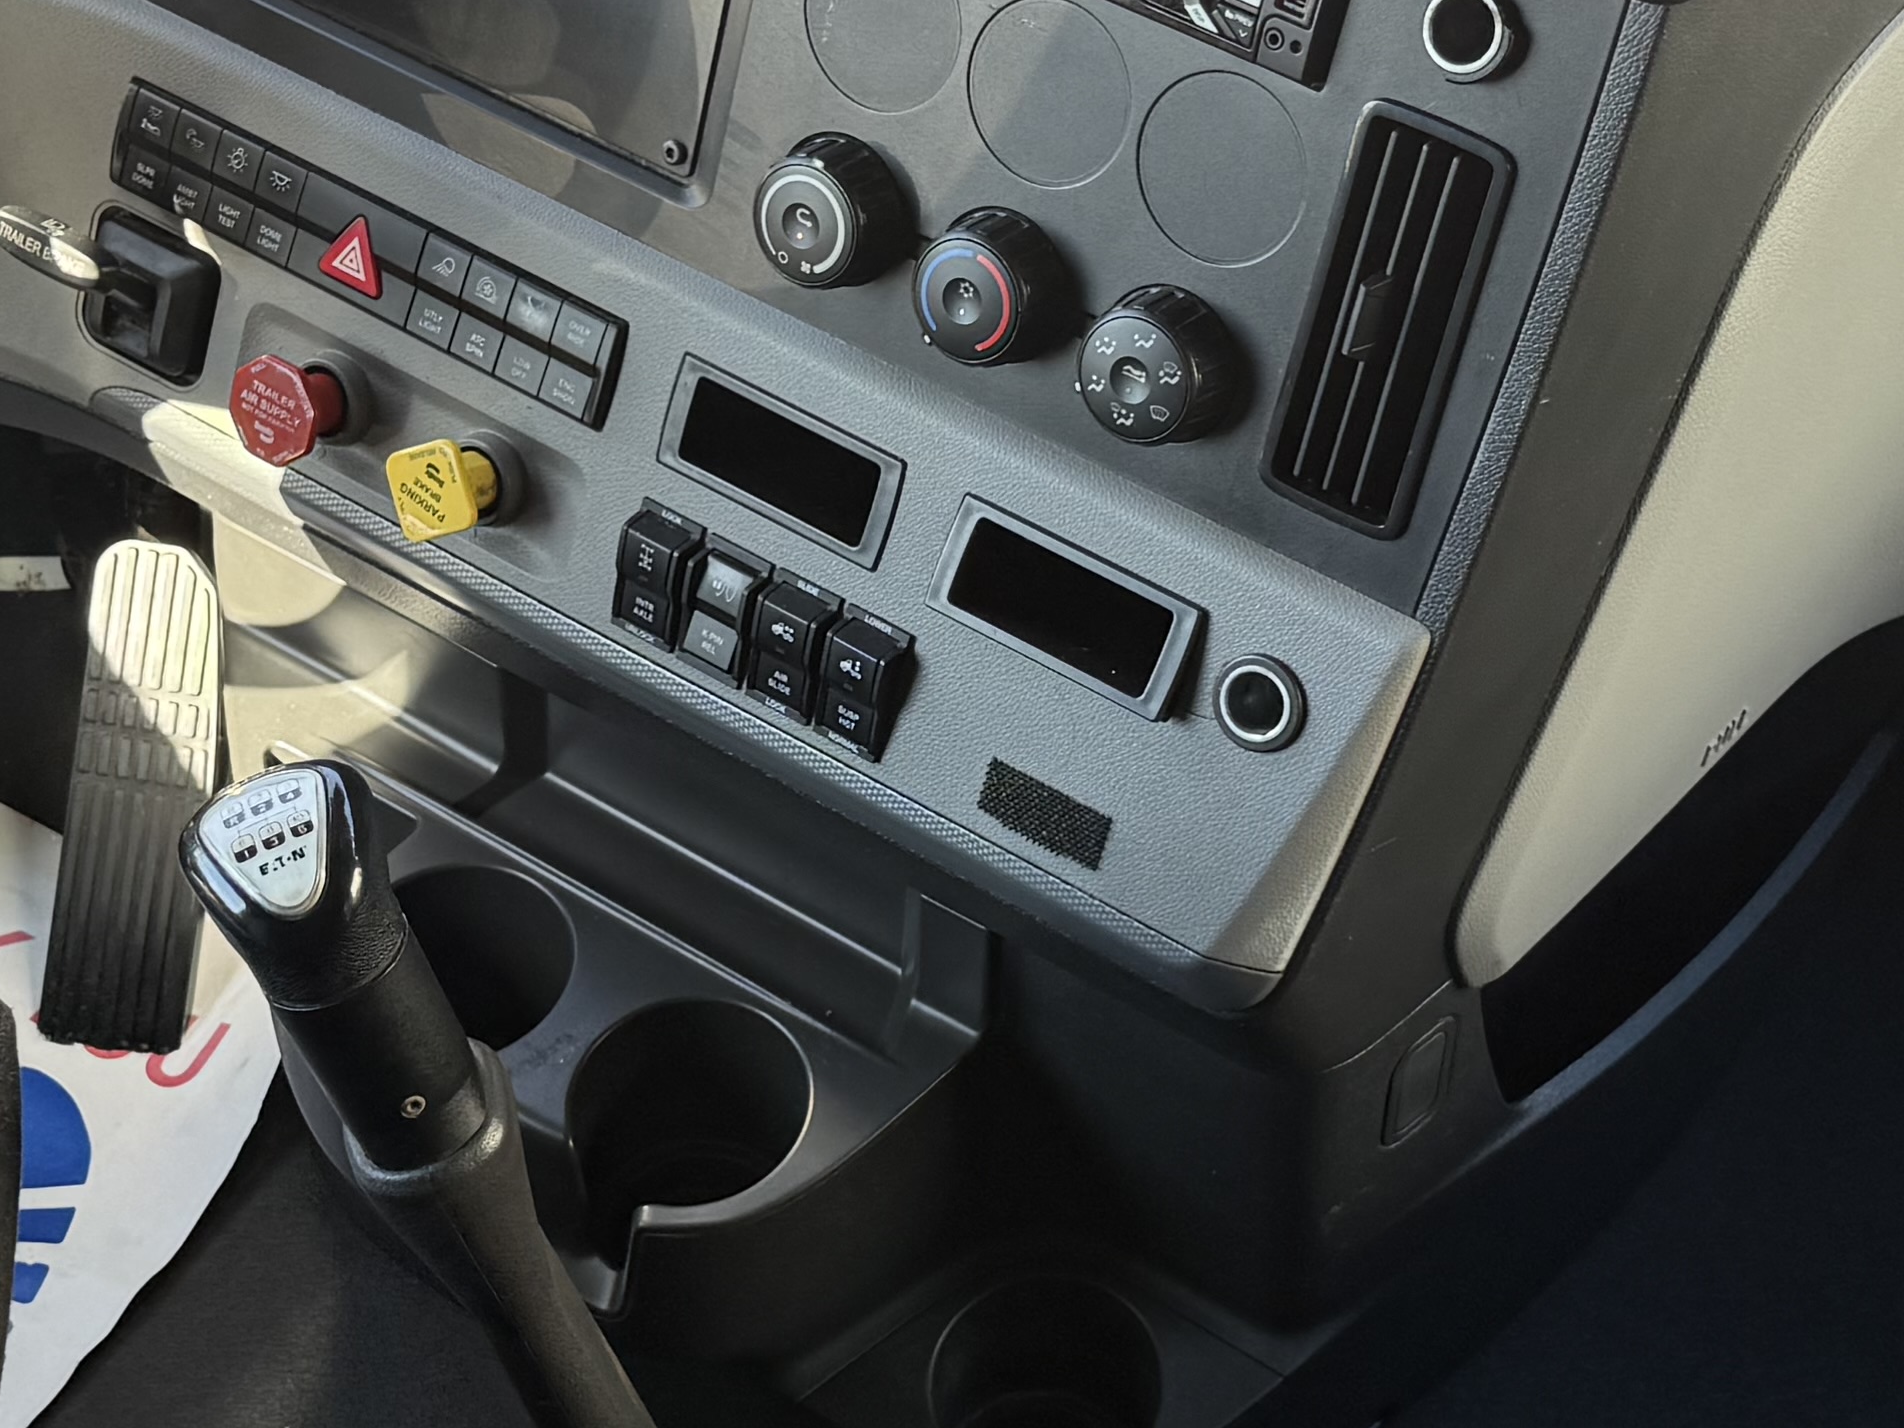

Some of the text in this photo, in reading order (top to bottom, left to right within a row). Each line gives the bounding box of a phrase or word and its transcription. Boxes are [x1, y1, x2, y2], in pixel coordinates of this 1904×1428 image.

[218, 204, 241, 219] LIGHT
[218, 214, 236, 228] TEST
[260, 225, 283, 242] DOME
[257, 236, 280, 252] LIGHT
[418, 319, 442, 334] LIGHT
[252, 379, 296, 410] TRAILER
[240, 389, 259, 406] AIR
[260, 399, 301, 428] SUPPLY
[413, 477, 442, 503] BRAKE
[399, 482, 446, 523] PARKING
[864, 614, 893, 635] LOWER
